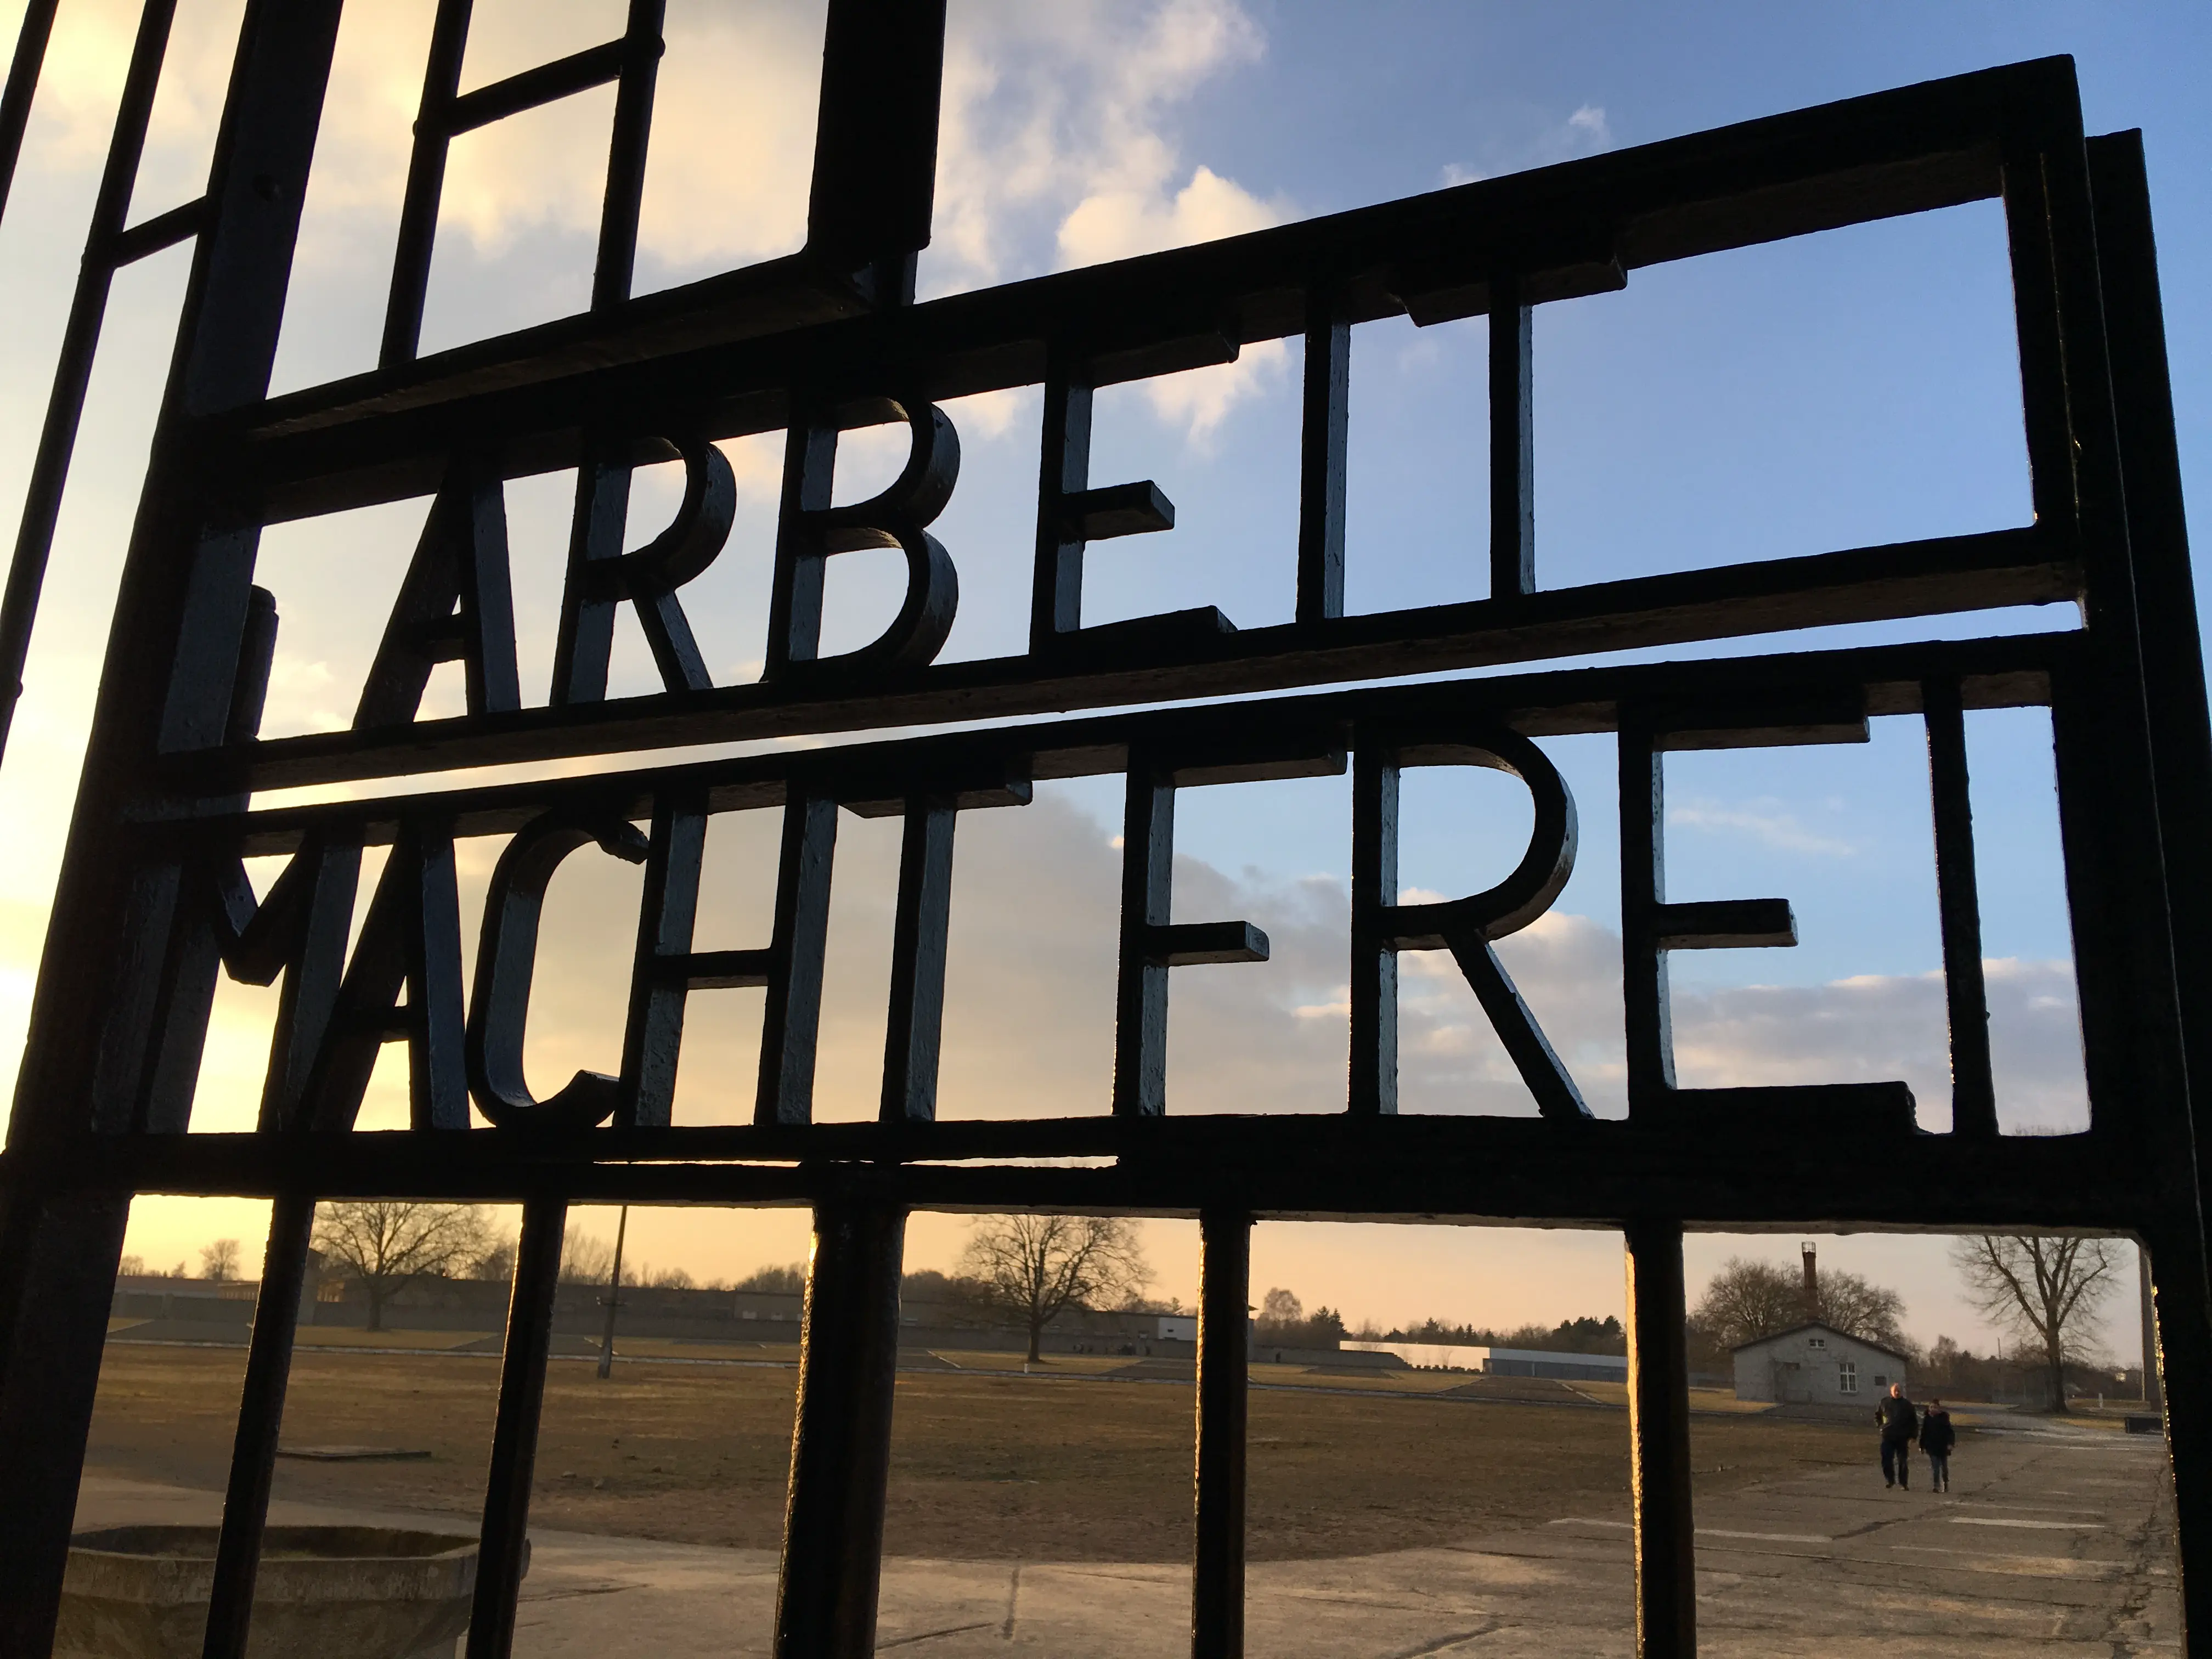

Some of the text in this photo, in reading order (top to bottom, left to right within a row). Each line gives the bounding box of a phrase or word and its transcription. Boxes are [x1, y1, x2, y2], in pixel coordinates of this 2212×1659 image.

[351, 219, 1628, 738] ARBEIT
[132, 676, 1998, 1138] MACHT FREI
